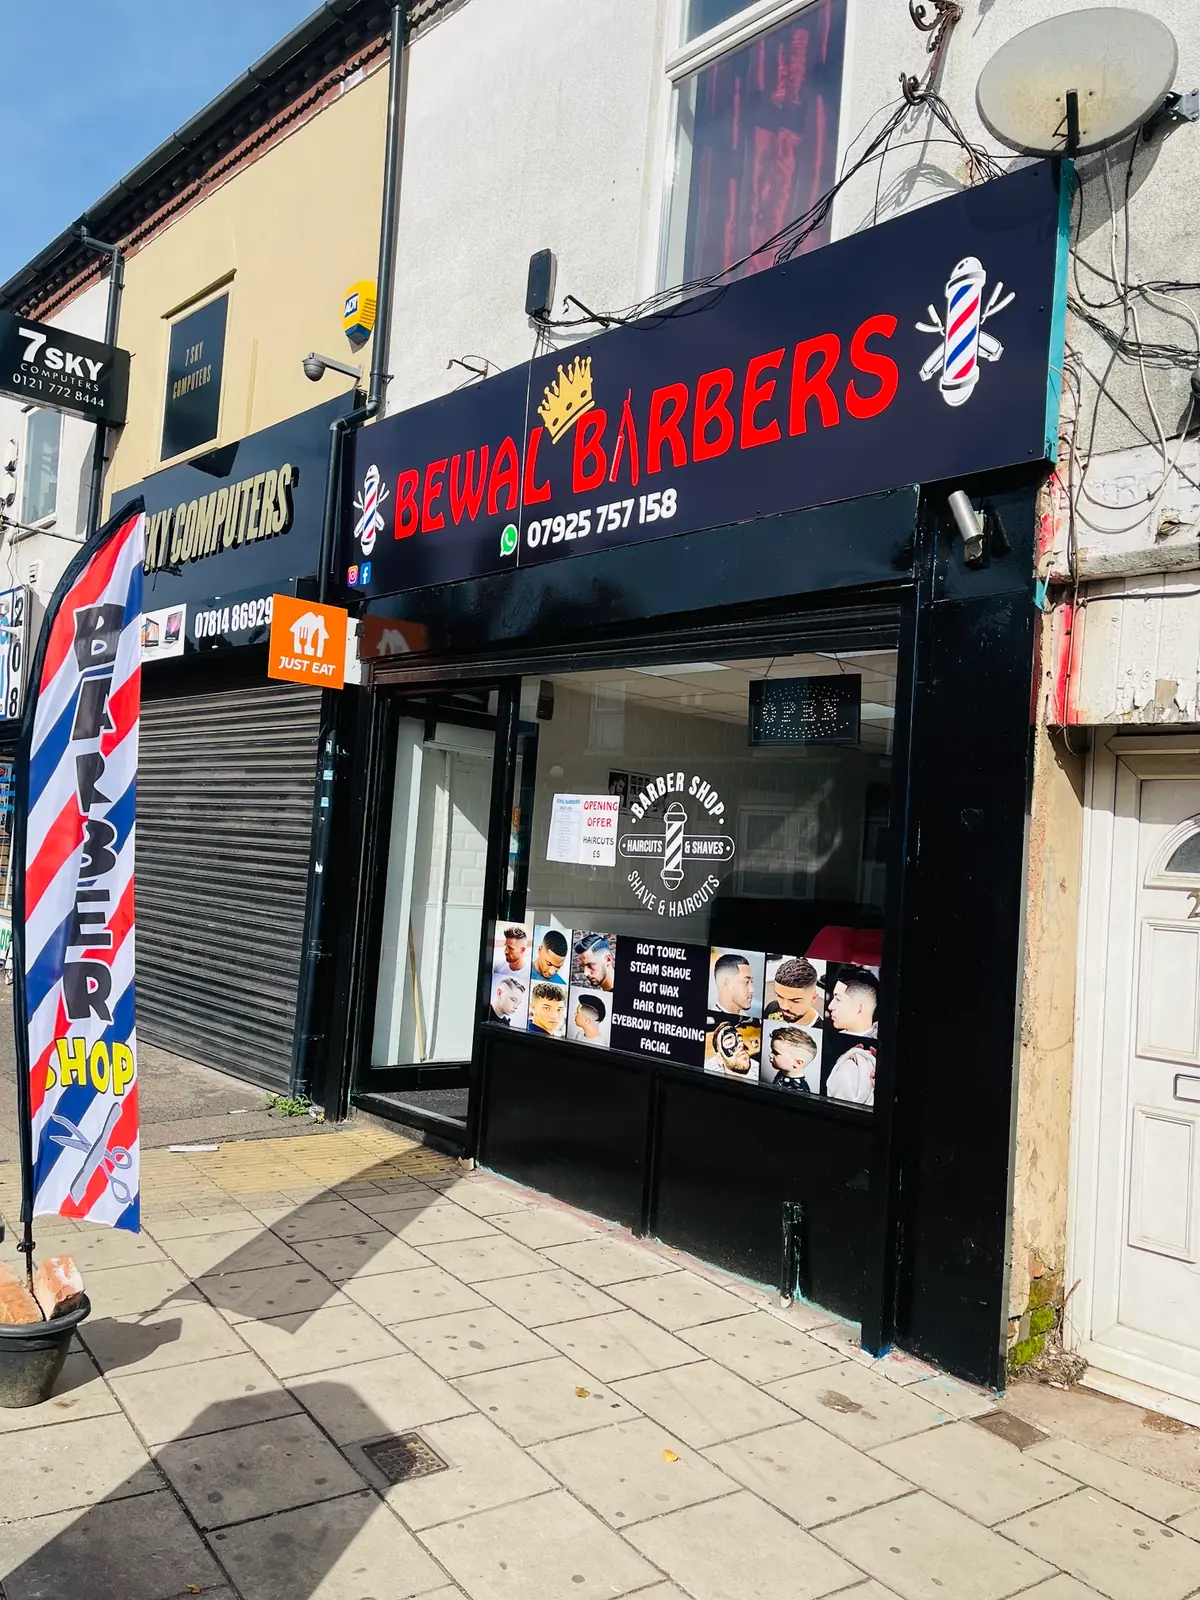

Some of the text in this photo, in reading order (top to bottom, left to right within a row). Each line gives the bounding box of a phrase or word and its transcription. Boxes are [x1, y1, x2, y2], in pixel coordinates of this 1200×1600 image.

[18, 327, 104, 382] 7 SKY
[190, 341, 204, 364] SKY
[12, 373, 105, 407] 0121 772 8444
[20, 363, 100, 392] COMPUTERS
[173, 364, 212, 400] COMPUTERS
[394, 313, 899, 540] BEWAL BARBERS
[170, 463, 292, 564] COMPUTERS
[527, 488, 678, 548] 07925 757 158
[194, 607, 230, 639] 07814
[278, 656, 337, 676] JUST EAT
[762, 698, 840, 723] OPEN
[583, 800, 619, 811] OPENING
[630, 771, 725, 819] BARBER SHOP
[587, 817, 612, 828] OFFER
[582, 836, 615, 846] HAIRCUTS
[627, 839, 724, 855] HAIRCUTS & SHAVES
[627, 870, 720, 918] SHAVE & HAIRCUTS
[636, 943, 687, 960] HOT TOWEL
[630, 961, 692, 980] STEAM SHAVE
[639, 980, 679, 998] HOT WAX
[633, 998, 683, 1018] HAIR DYING
[611, 1013, 705, 1042] EYEBROW THREADING
[640, 1037, 671, 1055] FACIAL
